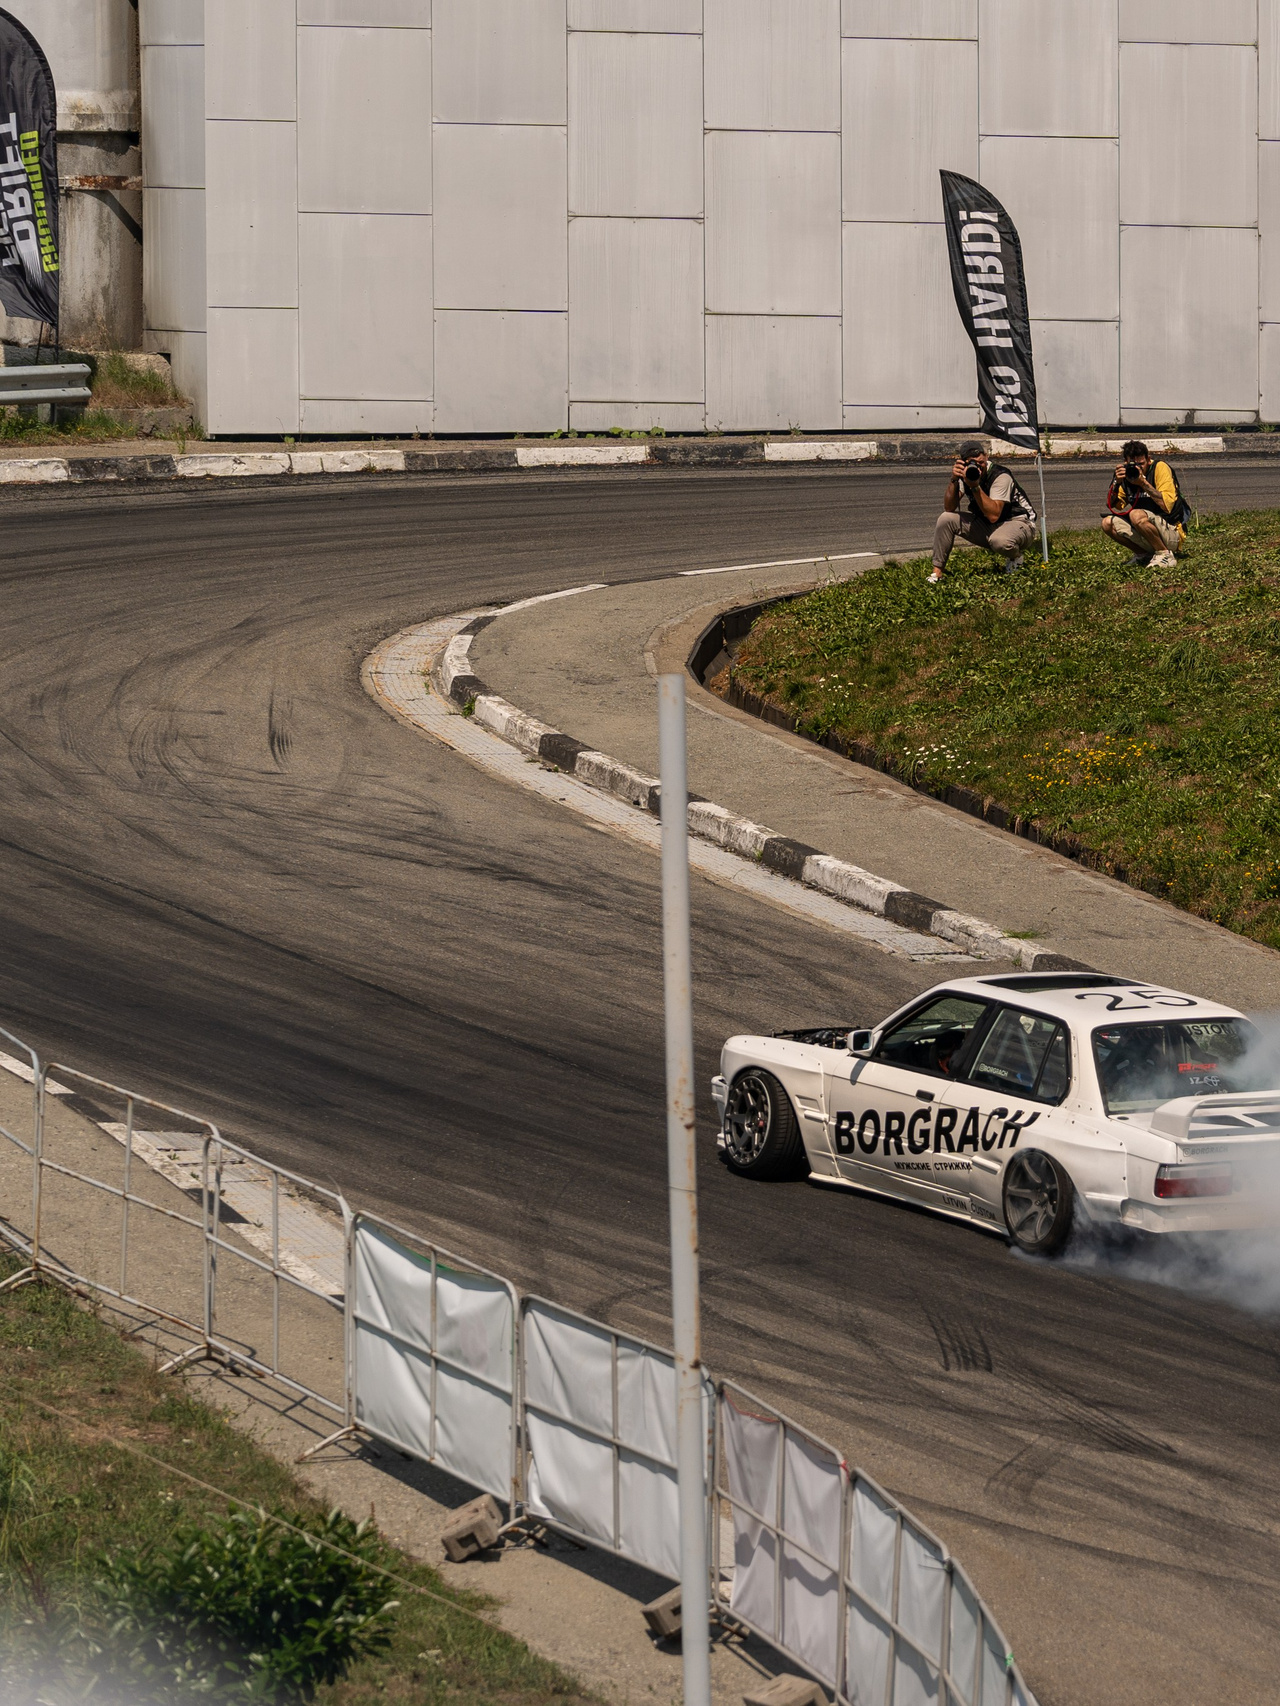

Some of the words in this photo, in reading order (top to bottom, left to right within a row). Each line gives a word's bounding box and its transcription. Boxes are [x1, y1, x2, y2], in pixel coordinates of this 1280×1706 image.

[1074, 990, 1198, 1011] 25
[1187, 1024, 1236, 1037] USTOM
[835, 1106, 1042, 1156] BORGRACH
[894, 1161, 932, 1171] МУЖСКИЕ
[934, 1161, 973, 1171] СТРИЖКИ
[942, 1195, 968, 1211] LITVIN
[970, 1203, 997, 1221] CUSTOM
